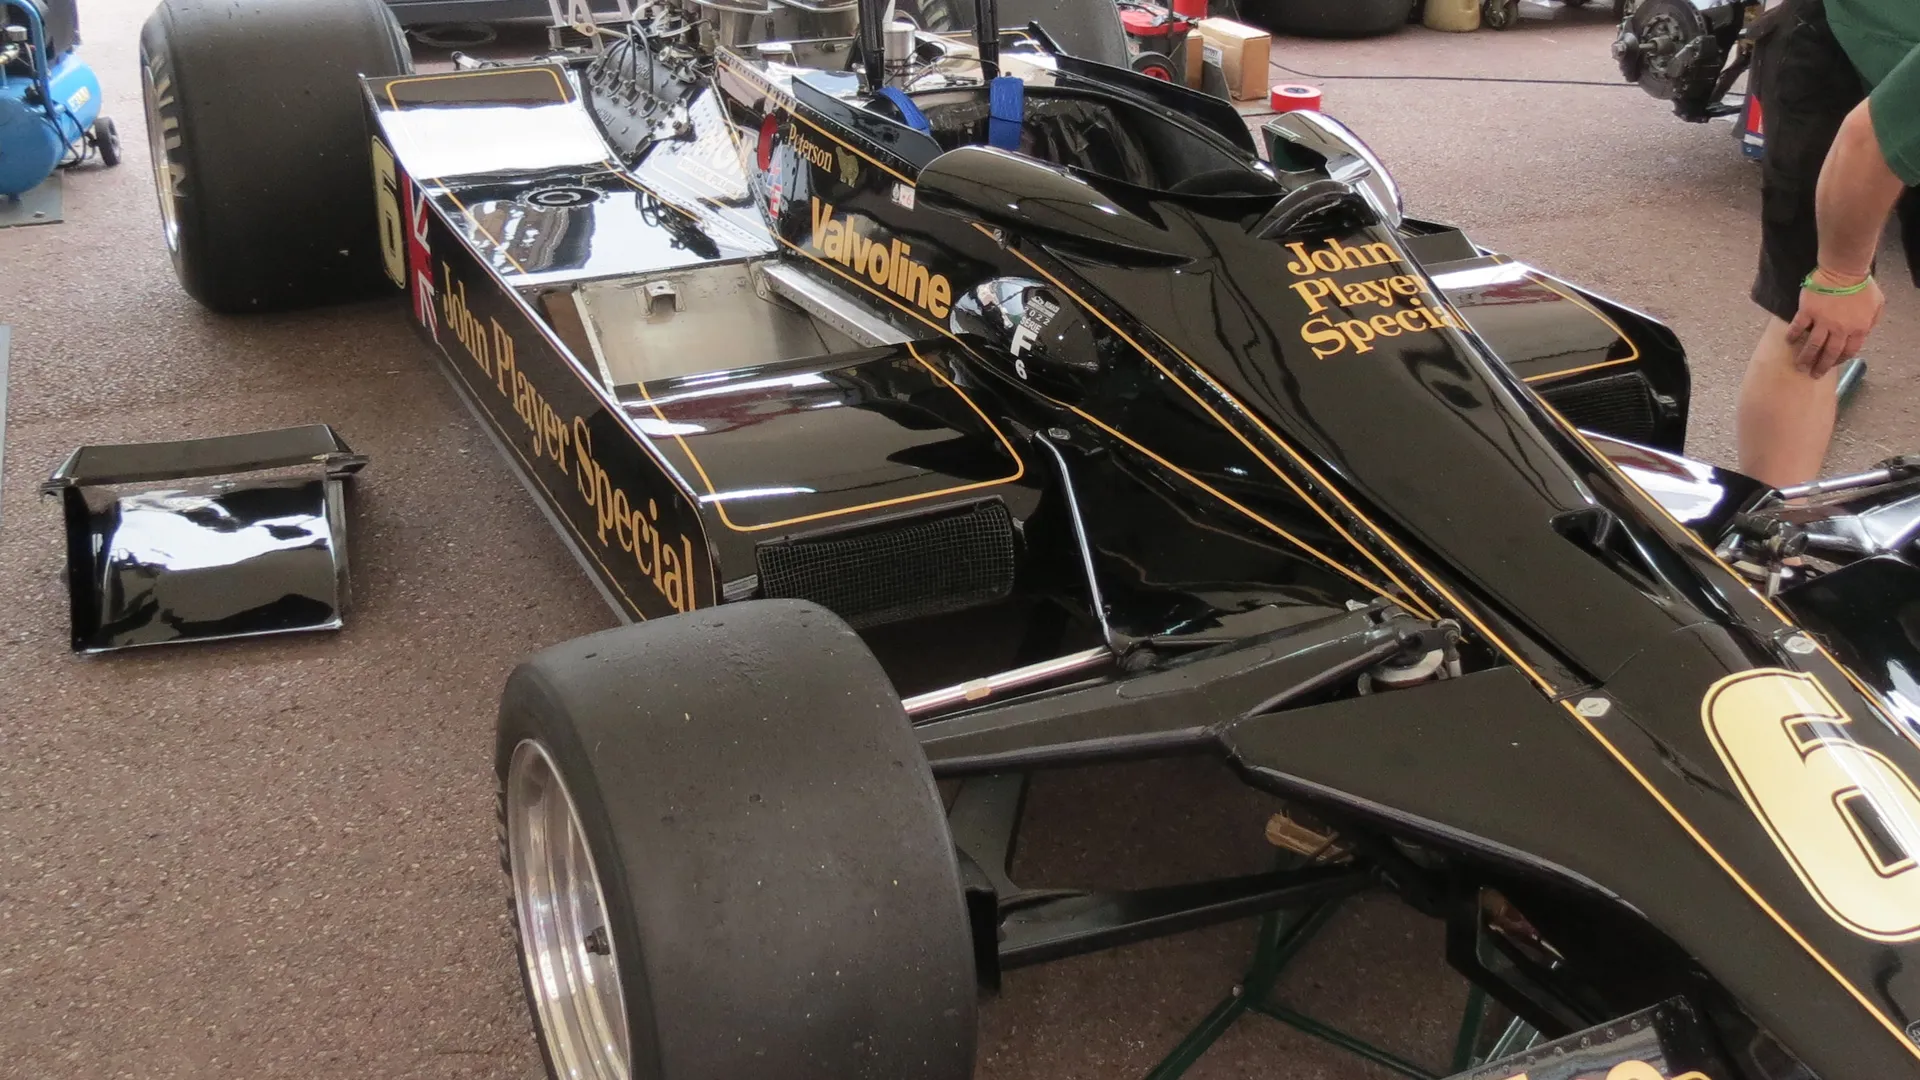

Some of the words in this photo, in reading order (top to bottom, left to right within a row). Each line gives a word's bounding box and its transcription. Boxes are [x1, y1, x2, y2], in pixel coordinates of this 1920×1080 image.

[787, 123, 833, 173] Peterson
[371, 134, 406, 290] 6
[812, 196, 951, 319] Valvoline
[1285, 238, 1404, 275] John
[1010, 324, 1038, 357] F
[1023, 306, 1051, 326] 2022
[1015, 359, 1028, 380] 6
[442, 261, 492, 378] John
[490, 316, 570, 475] Player
[574, 416, 696, 613] Special
[1700, 667, 1920, 943] 6
